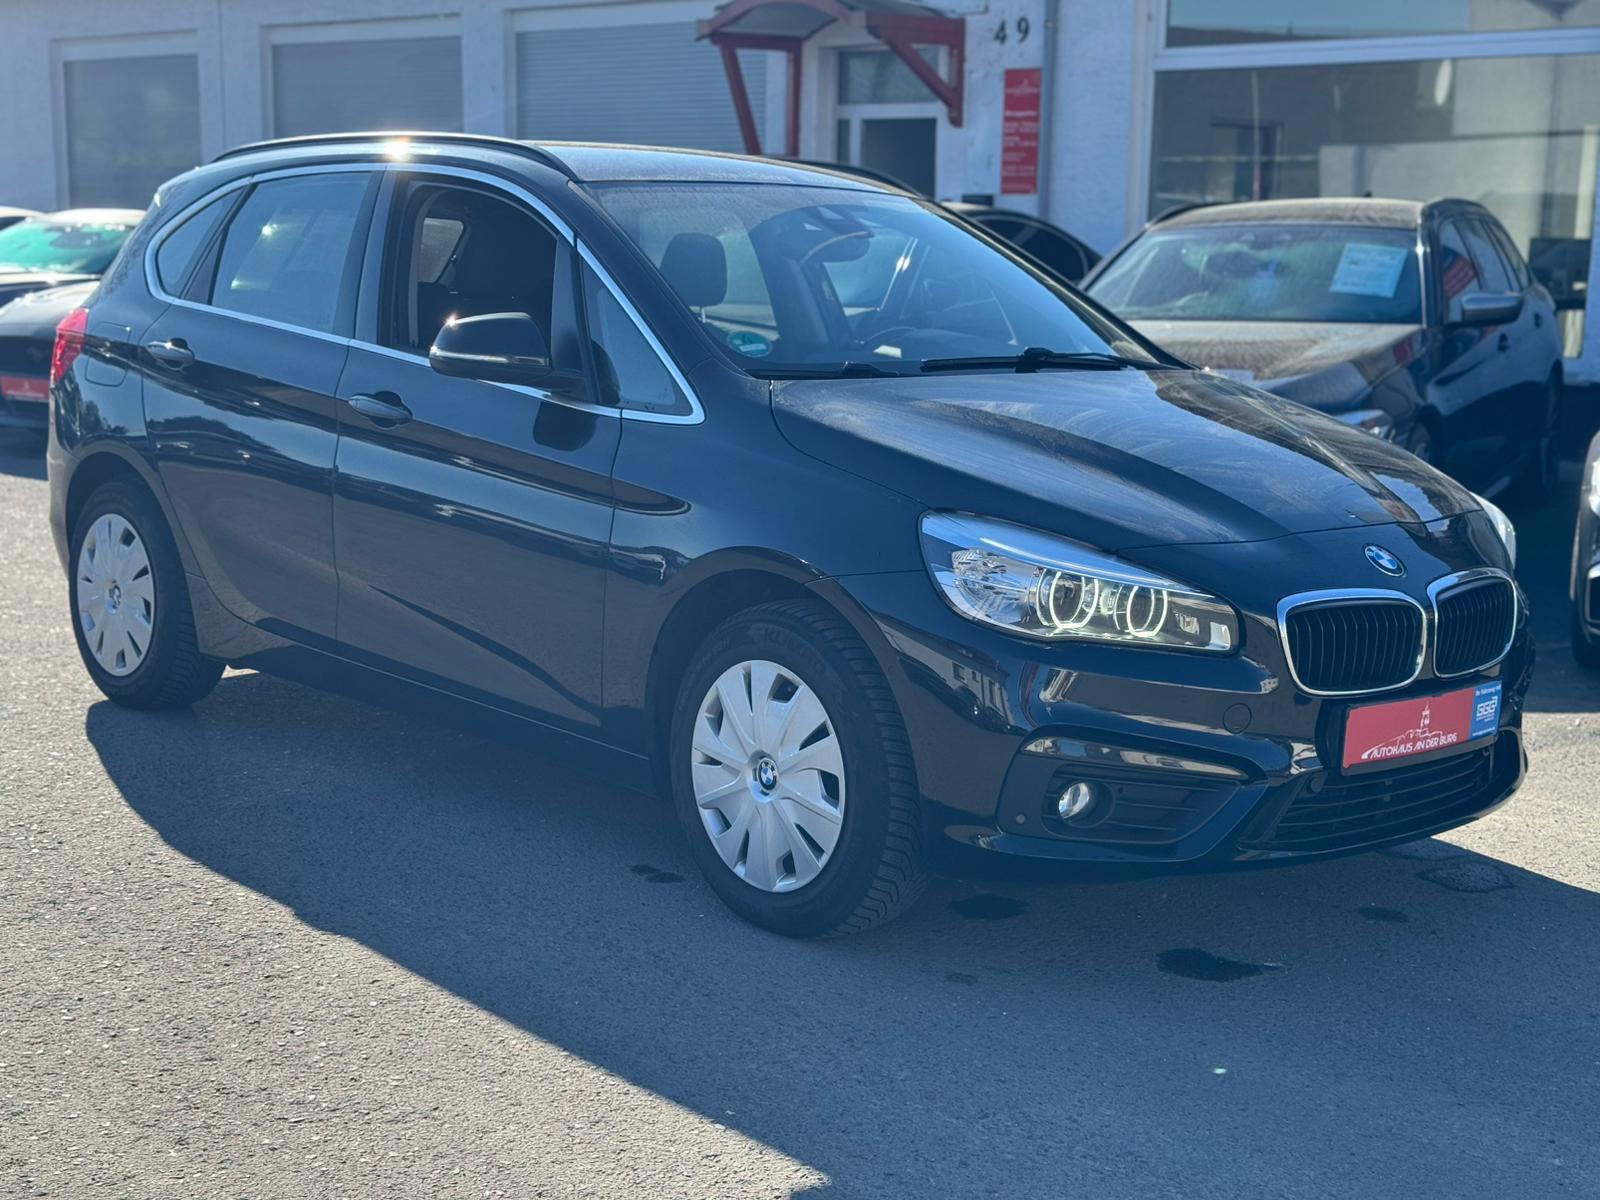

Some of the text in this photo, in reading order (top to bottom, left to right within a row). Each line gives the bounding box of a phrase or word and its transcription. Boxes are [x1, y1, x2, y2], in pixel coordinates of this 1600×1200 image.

[994, 16, 1031, 45] 49
[1369, 742, 1413, 759] AUTOHAUS
[1413, 739, 1425, 751] AN
[1425, 737, 1439, 749] DER
[1439, 732, 1458, 745] BURG
